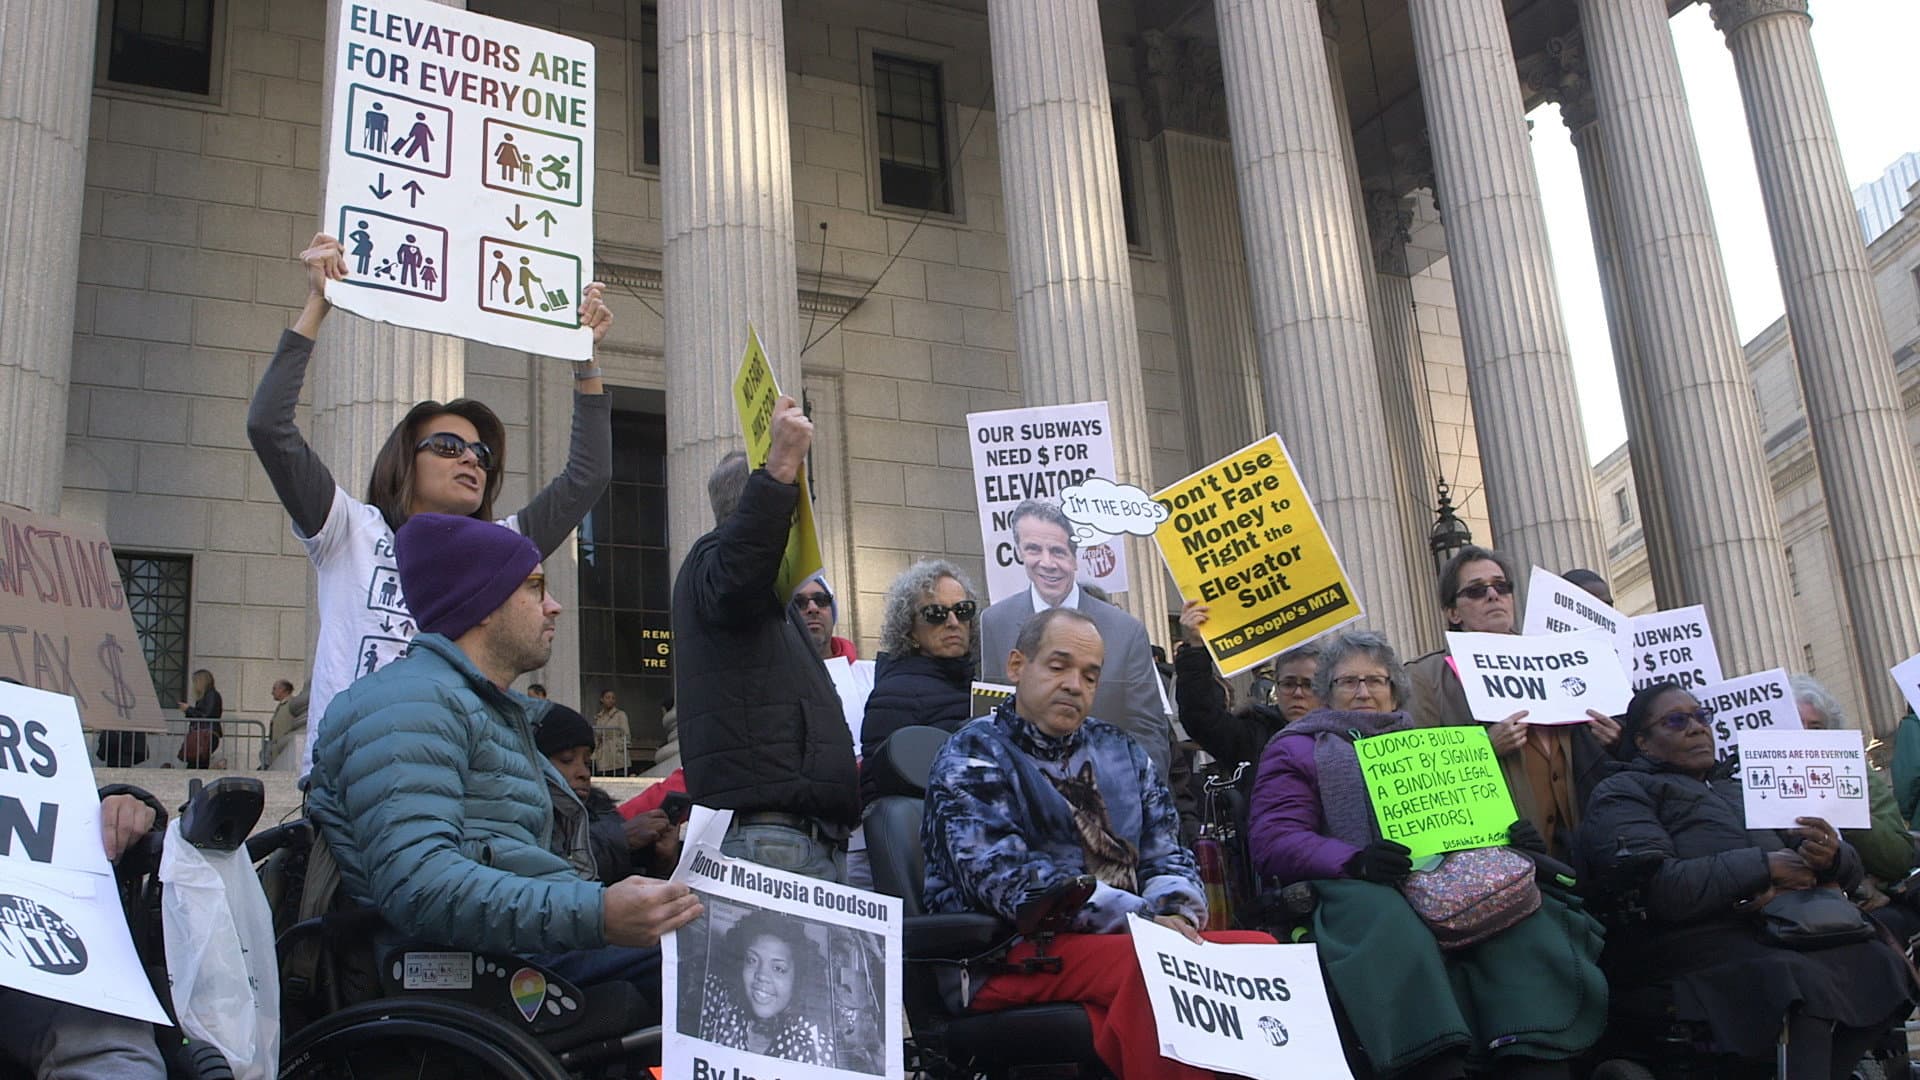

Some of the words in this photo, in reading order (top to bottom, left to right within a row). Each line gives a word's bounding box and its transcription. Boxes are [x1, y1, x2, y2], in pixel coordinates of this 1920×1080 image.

[350, 4, 521, 73] ELEVATORS
[528, 52, 588, 89] ARE
[347, 42, 409, 86] FOR
[419, 62, 588, 128] EVERYONE
[978, 426, 1014, 444] OUR
[1021, 419, 1102, 440] SUBWAYS
[986, 448, 1032, 467] NEED
[1038, 445, 1050, 468] $
[1054, 444, 1088, 462] FOR
[1222, 452, 1273, 484] Use
[1091, 498, 1120, 516] THE
[1122, 499, 1162, 519] BOSS
[1174, 502, 1217, 534] Our
[1221, 474, 1280, 511] Fare
[1181, 504, 1265, 556] Money
[1270, 498, 1291, 514] to
[1194, 531, 1261, 575] Fight
[1264, 523, 1293, 543] the
[1199, 543, 1303, 603] Elevator
[1237, 572, 1292, 609] Suit
[1214, 633, 1244, 652] The
[1243, 604, 1308, 641] People's
[1308, 588, 1341, 612] MTA
[1553, 591, 1574, 612] OUR
[1575, 601, 1617, 634] SUBWAYS
[656, 642, 670, 655] 6
[1633, 622, 1703, 648] UBWAYS
[1473, 650, 1589, 672] ELEVATORS
[1643, 652, 1657, 673] $
[1659, 647, 1693, 666] FOR
[97, 633, 136, 720] $
[1482, 675, 1547, 700] NOW
[1704, 682, 1784, 714] UBWAYS
[1715, 719, 1731, 741] $
[1734, 709, 1775, 731] FOR
[1361, 732, 1425, 760] CUOMO:
[1745, 750, 1787, 759] ELEVATORS
[1789, 750, 1805, 759] ARE
[1805, 750, 1820, 759] FOR
[1821, 750, 1860, 759] EVERYONE
[1367, 756, 1414, 780] TRUST
[1377, 785, 1388, 800] A
[1394, 770, 1456, 796] BINDING
[1459, 766, 1494, 782] LEGAL
[1383, 787, 1467, 821] AGREEMENT
[1471, 783, 1500, 800] FOR
[1387, 808, 1475, 840] ELEVATORS!
[689, 849, 728, 882] Honor
[730, 865, 810, 905] Malaysia
[813, 885, 889, 922] Goodson
[12, 896, 45, 916] THE
[1157, 952, 1291, 1001] ELEVATORS
[1169, 985, 1244, 1041] NOW
